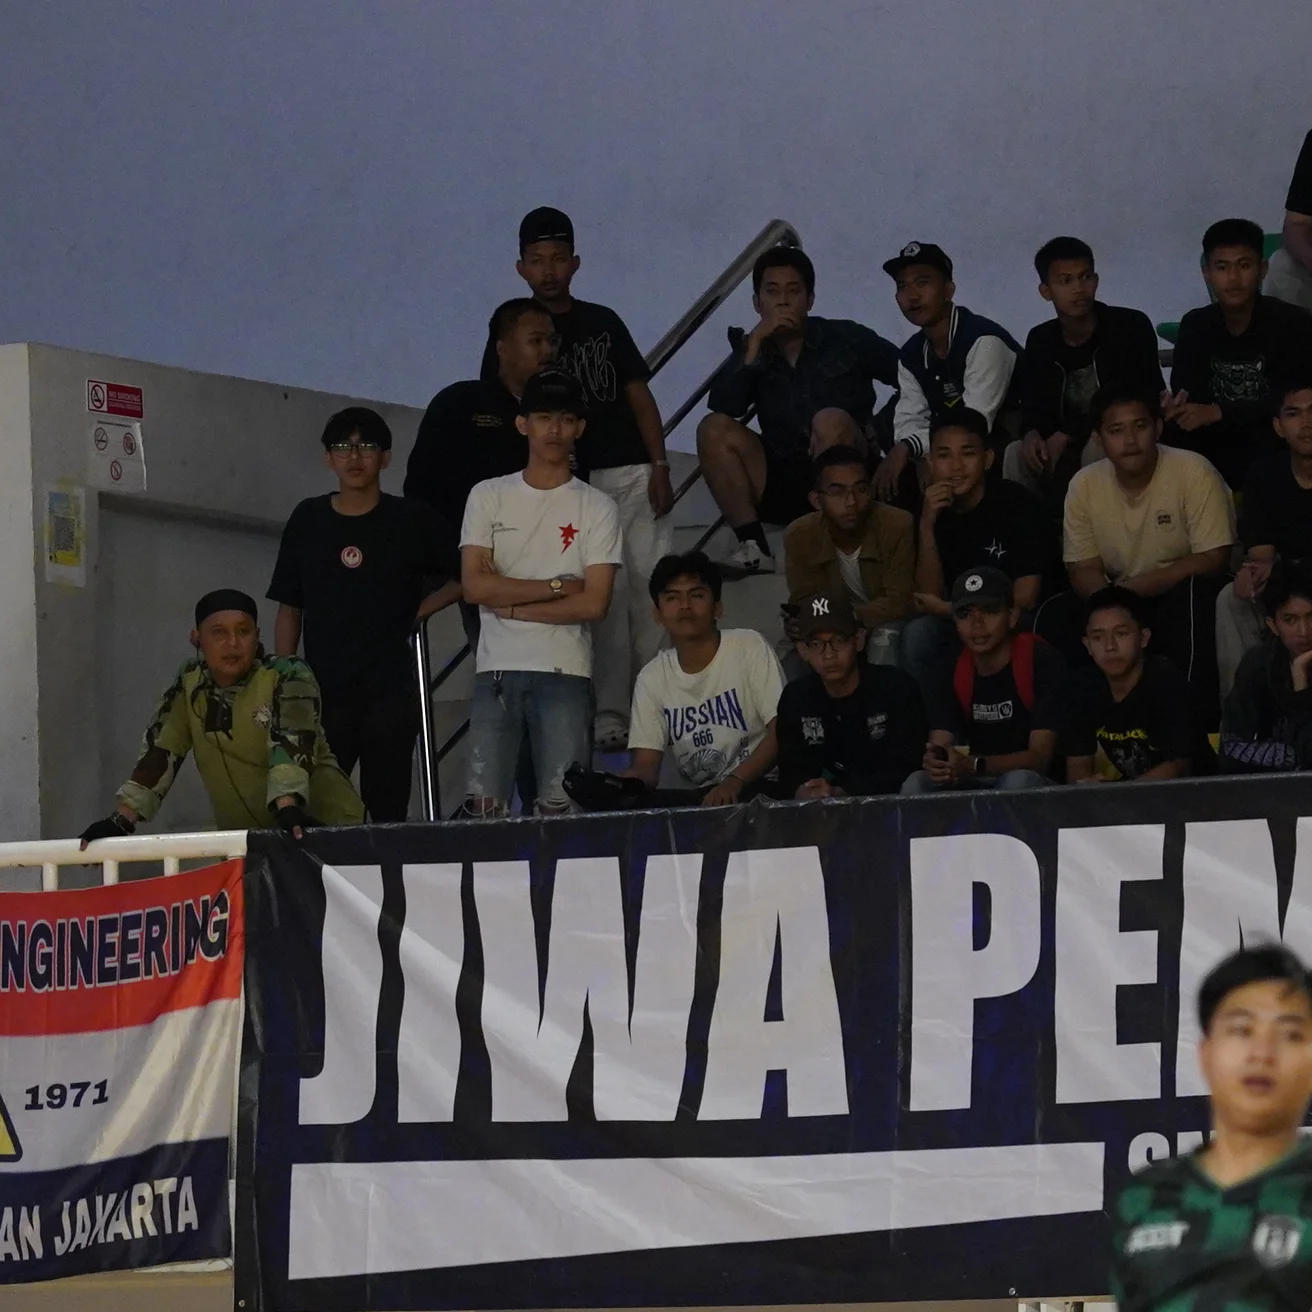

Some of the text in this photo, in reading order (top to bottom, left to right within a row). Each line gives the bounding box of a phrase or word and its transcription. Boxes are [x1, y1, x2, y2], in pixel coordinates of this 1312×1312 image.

[692, 728, 714, 748] 666
[298, 845, 850, 1126] JIWA
[24, 1078, 109, 1112] 1971
[54, 1176, 200, 1256] JAKARTA
